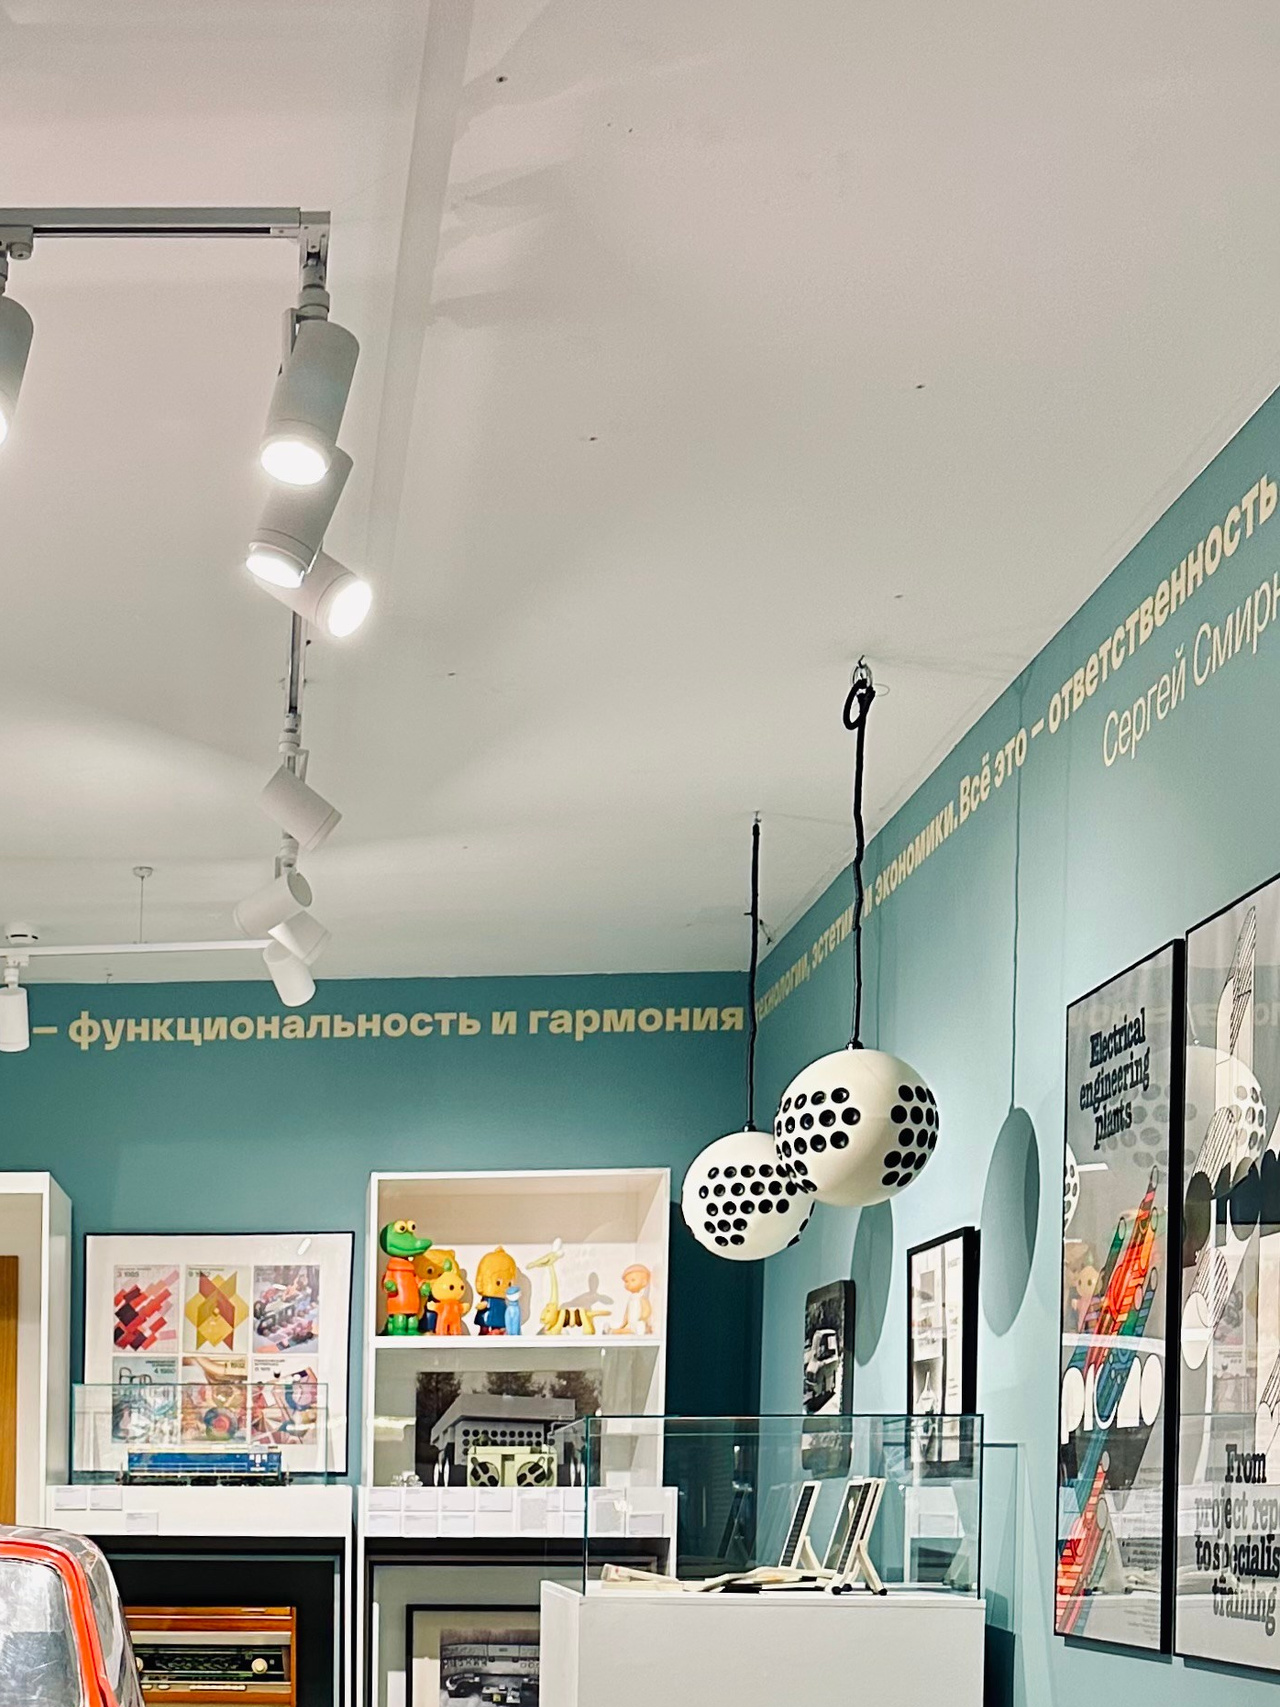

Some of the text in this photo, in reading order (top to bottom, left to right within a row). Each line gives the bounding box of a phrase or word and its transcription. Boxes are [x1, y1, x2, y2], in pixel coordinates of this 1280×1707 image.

[812, 901, 853, 969] эстети
[959, 752, 991, 825] Всё
[994, 727, 1028, 788] это
[1048, 474, 1279, 735] ответственность
[1103, 643, 1187, 768] Сергей
[68, 1010, 481, 1051] функциональность
[492, 1011, 518, 1035] и
[528, 1005, 744, 1041] гармония
[1090, 1007, 1146, 1068] Electrical
[1079, 1046, 1150, 1114] engineering
[1093, 1098, 1133, 1150] plants
[1224, 1443, 1267, 1484] From
[1194, 1486, 1249, 1539] project
[1252, 1497, 1280, 1535] rep
[1194, 1535, 1212, 1572] to
[1211, 1577, 1278, 1637] training
